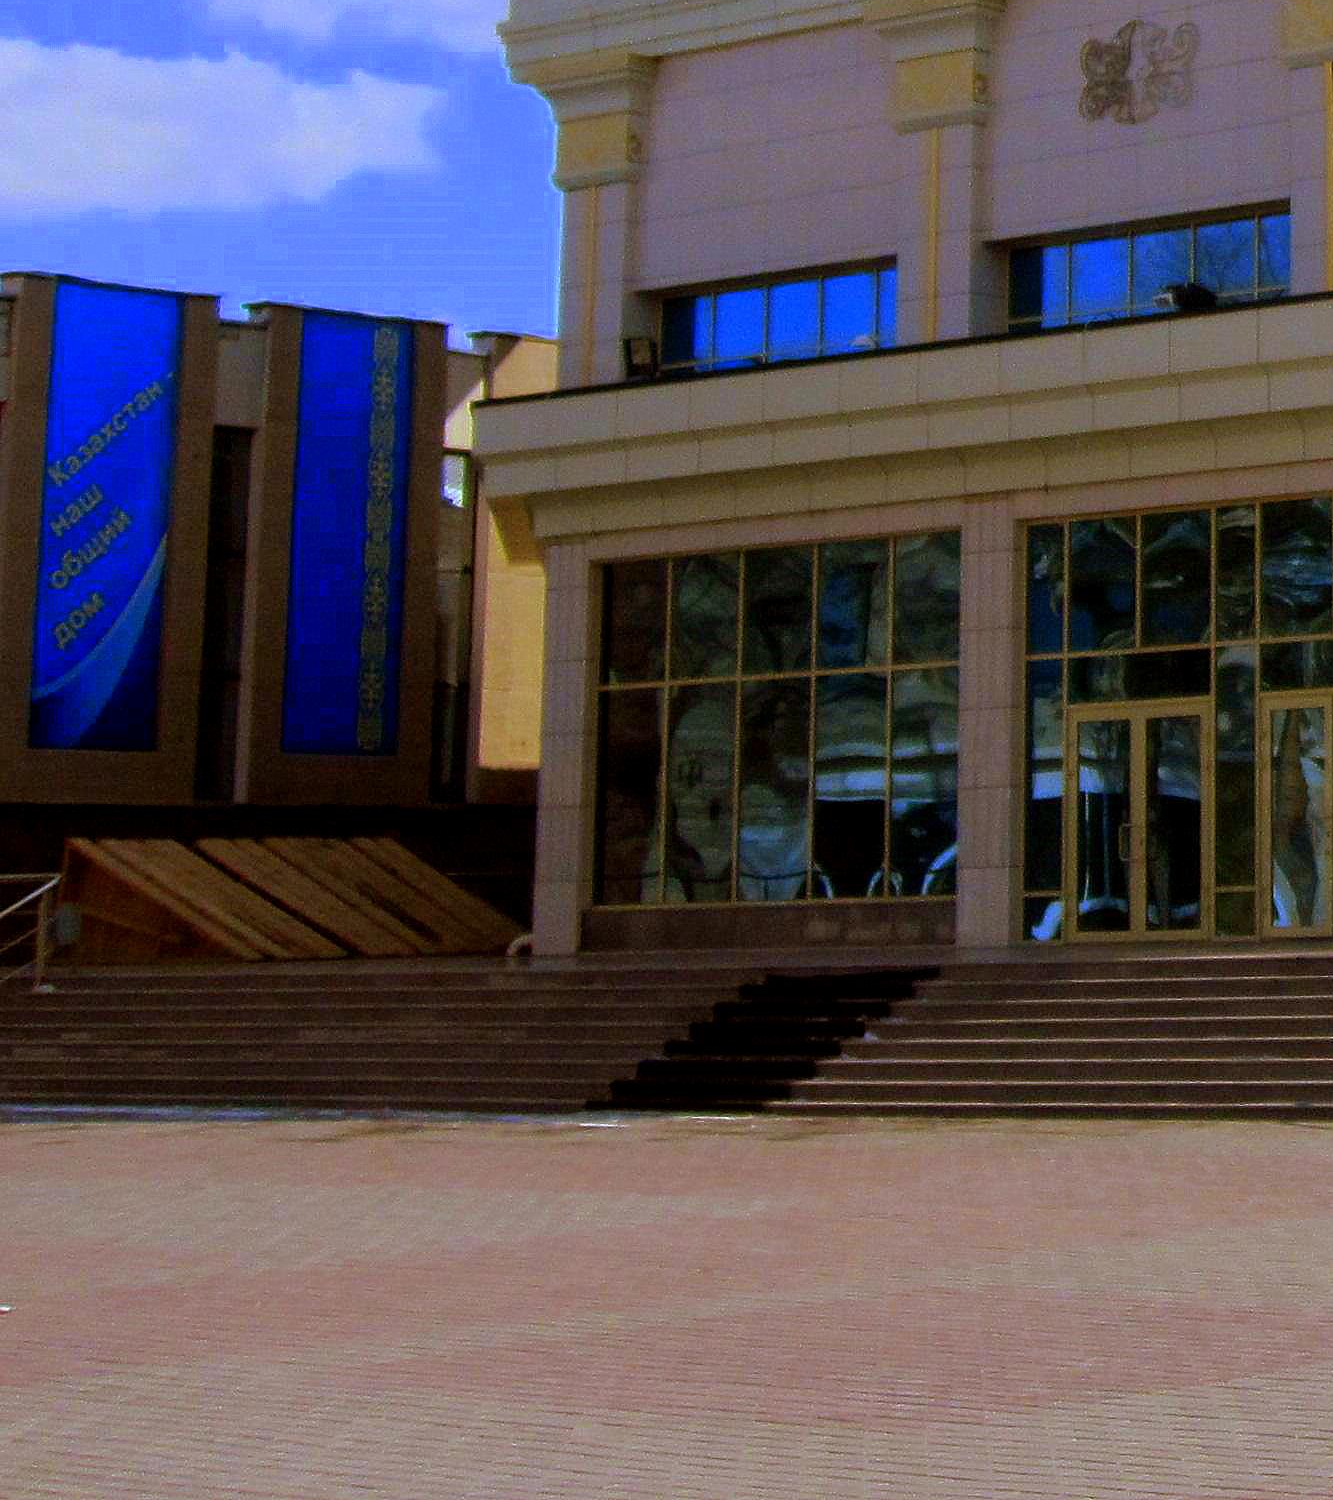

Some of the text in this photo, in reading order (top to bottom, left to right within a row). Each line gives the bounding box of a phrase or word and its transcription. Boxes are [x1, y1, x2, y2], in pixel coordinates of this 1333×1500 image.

[48, 381, 163, 487] Казахстан
[51, 484, 103, 537] наш
[54, 593, 104, 649] дом
